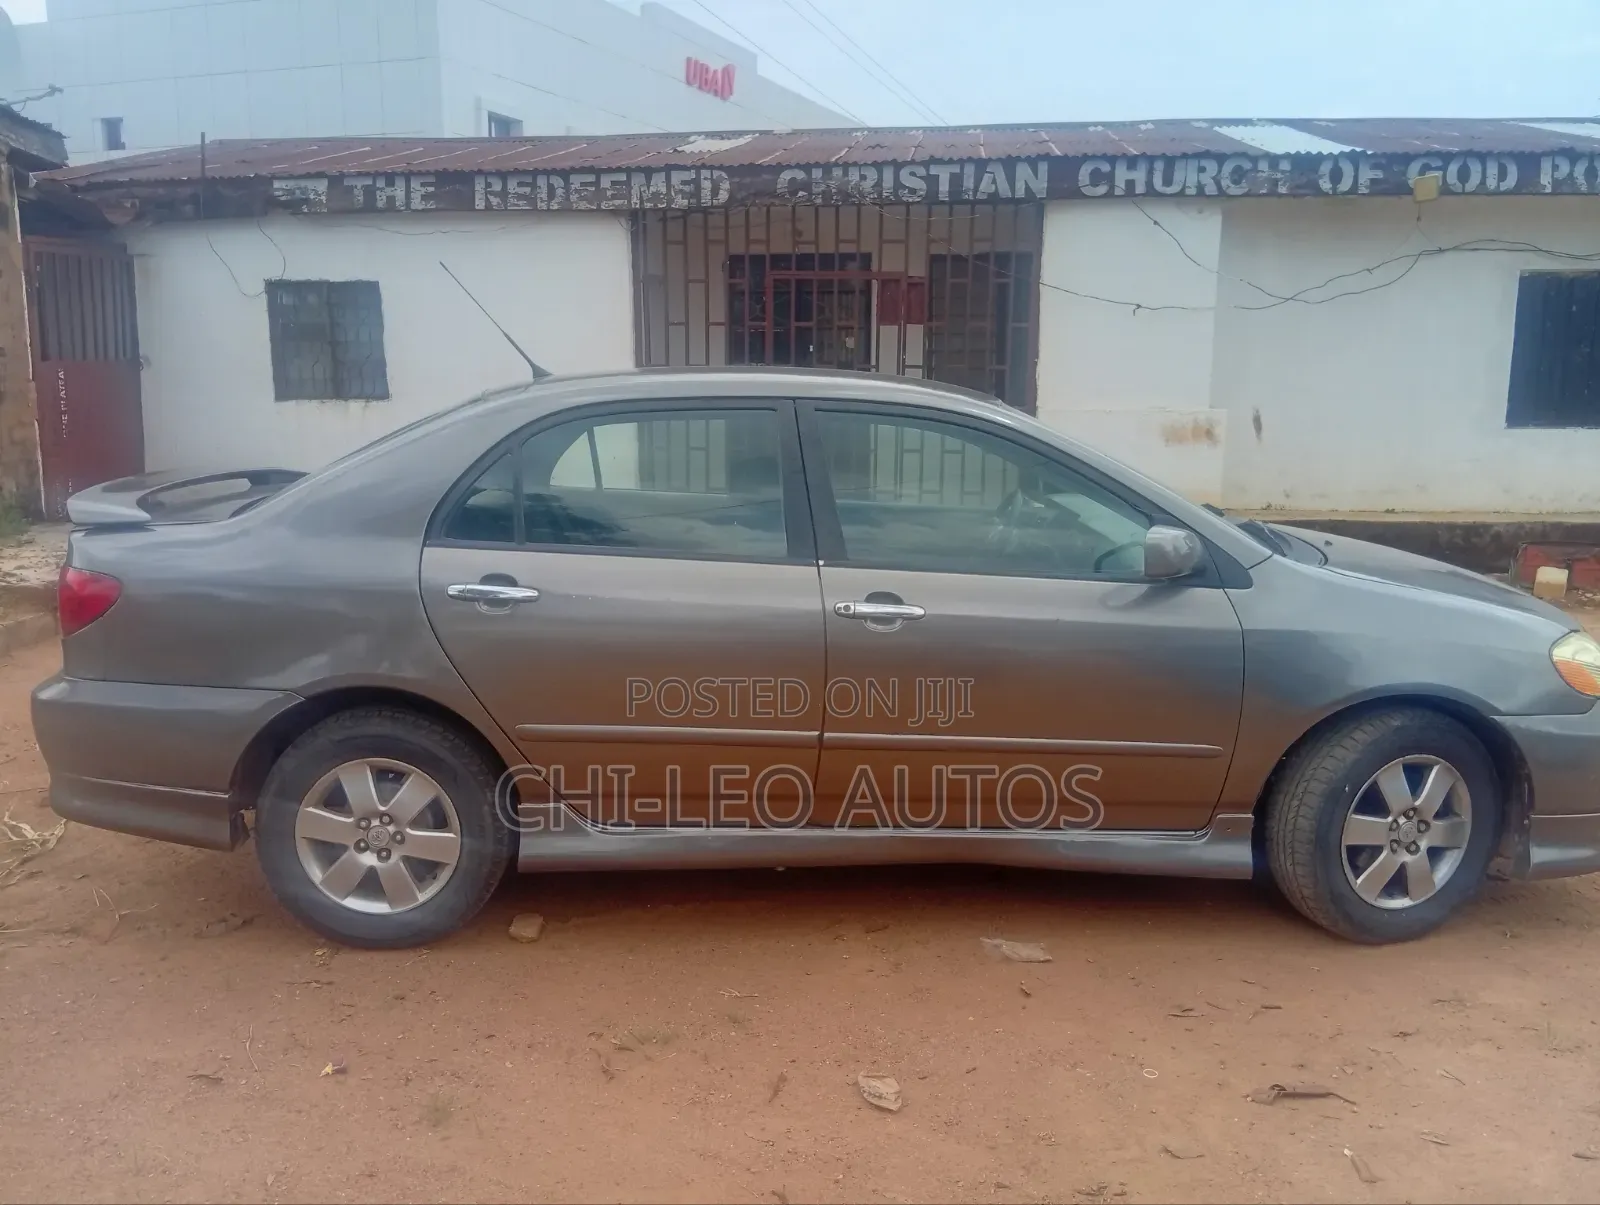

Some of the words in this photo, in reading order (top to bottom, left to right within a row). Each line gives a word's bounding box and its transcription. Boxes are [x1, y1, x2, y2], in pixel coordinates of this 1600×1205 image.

[343, 175, 436, 211] THE
[473, 169, 731, 211] REDEEMED
[776, 160, 1048, 204] CHRISTIAN
[1078, 154, 1292, 197] CHURCH
[1318, 155, 1388, 194] OF
[1406, 155, 1518, 193] GOD
